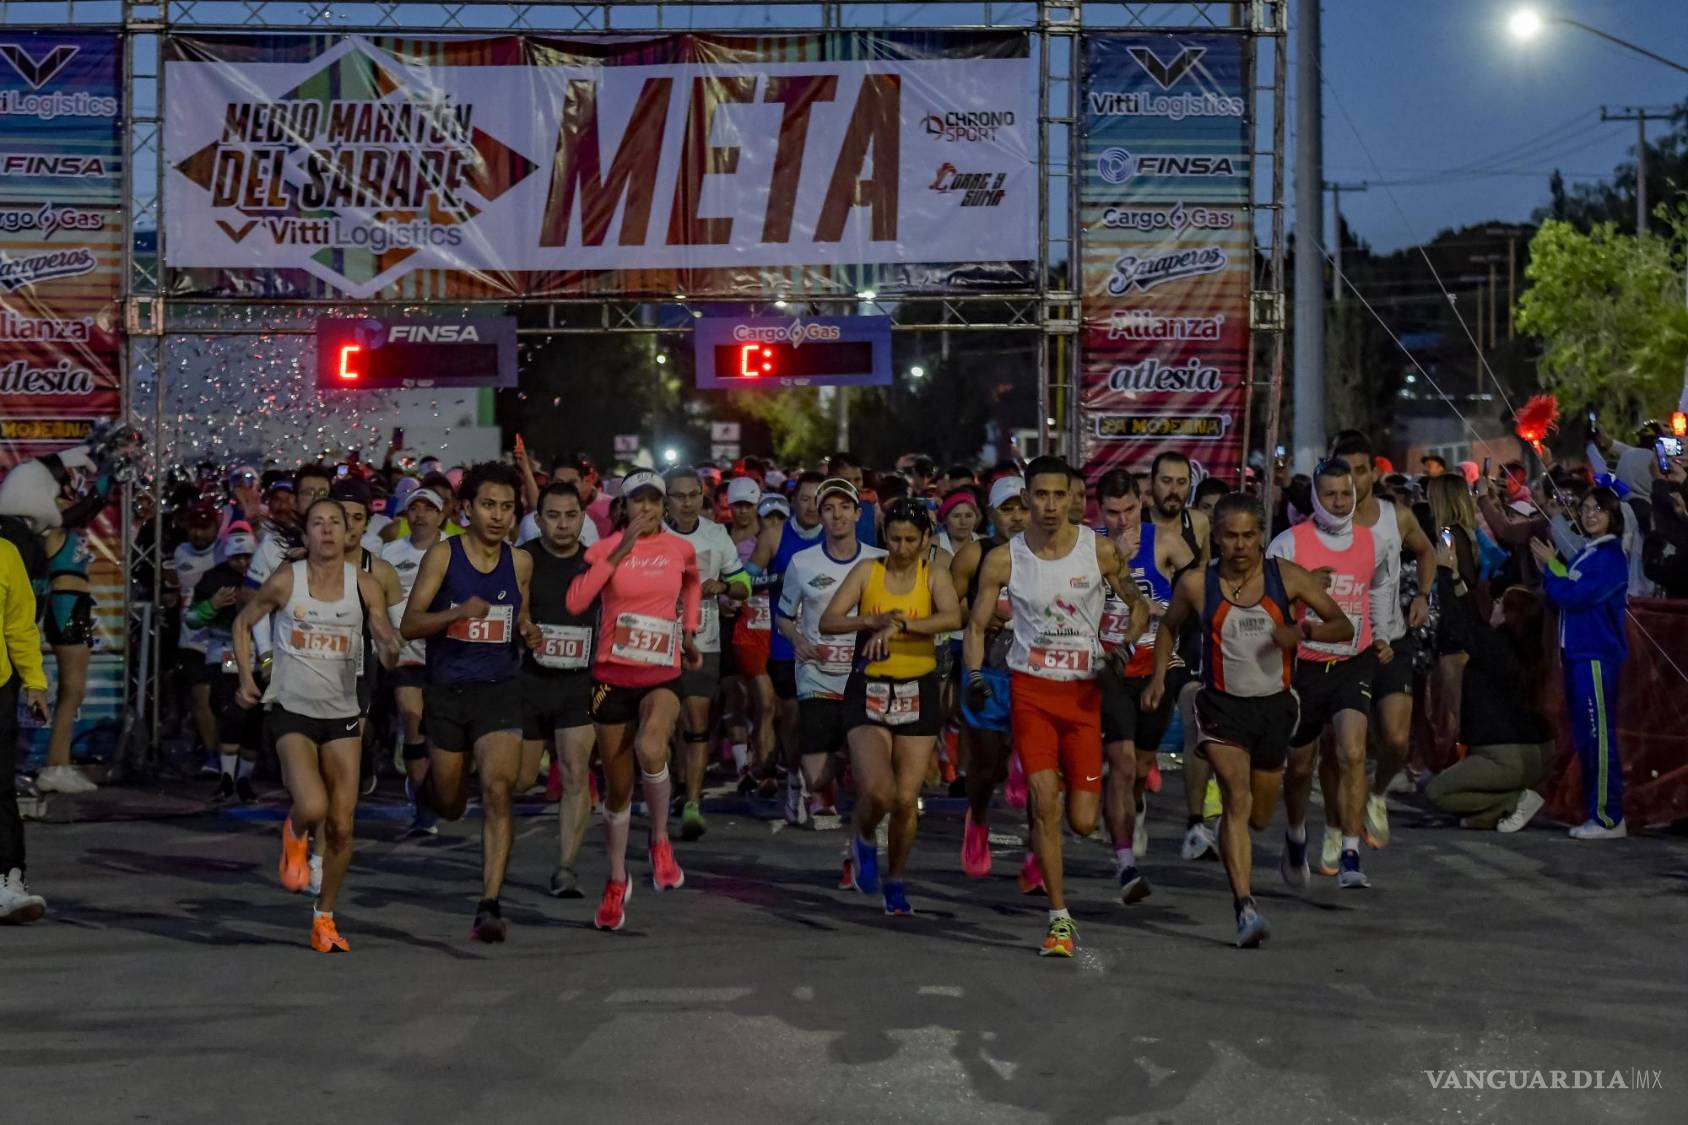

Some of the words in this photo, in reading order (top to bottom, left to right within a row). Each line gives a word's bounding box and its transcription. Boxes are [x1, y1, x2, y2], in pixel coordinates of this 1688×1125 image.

[12, 92, 116, 118] Logistics
[1091, 92, 1139, 113] Vitti
[1144, 92, 1243, 119] Logistics
[221, 102, 319, 144] MEDIO
[327, 94, 473, 144] MARATÓN
[945, 111, 1015, 127] CHRONO
[945, 126, 999, 142] SPORT
[3, 156, 104, 176] FINSA
[539, 73, 900, 248] META
[1137, 157, 1234, 174] FINSA
[211, 150, 289, 208] DEL
[301, 150, 466, 209] SARAPE
[60, 210, 101, 227] Gas
[1103, 208, 1167, 228] Cargo
[1191, 208, 1231, 226] Gas
[264, 219, 330, 245] Vitti
[335, 219, 463, 252] Logistics
[388, 325, 480, 343] FINSA
[734, 324, 787, 343] Cargo
[807, 323, 840, 339] Gas
[1110, 359, 1221, 391] atlesia
[1131, 417, 1220, 434] MODENA
[468, 621, 490, 640] 61
[628, 630, 663, 651] 537
[303, 632, 341, 652] 1621
[545, 639, 577, 657] 610
[1044, 649, 1080, 669] 621
